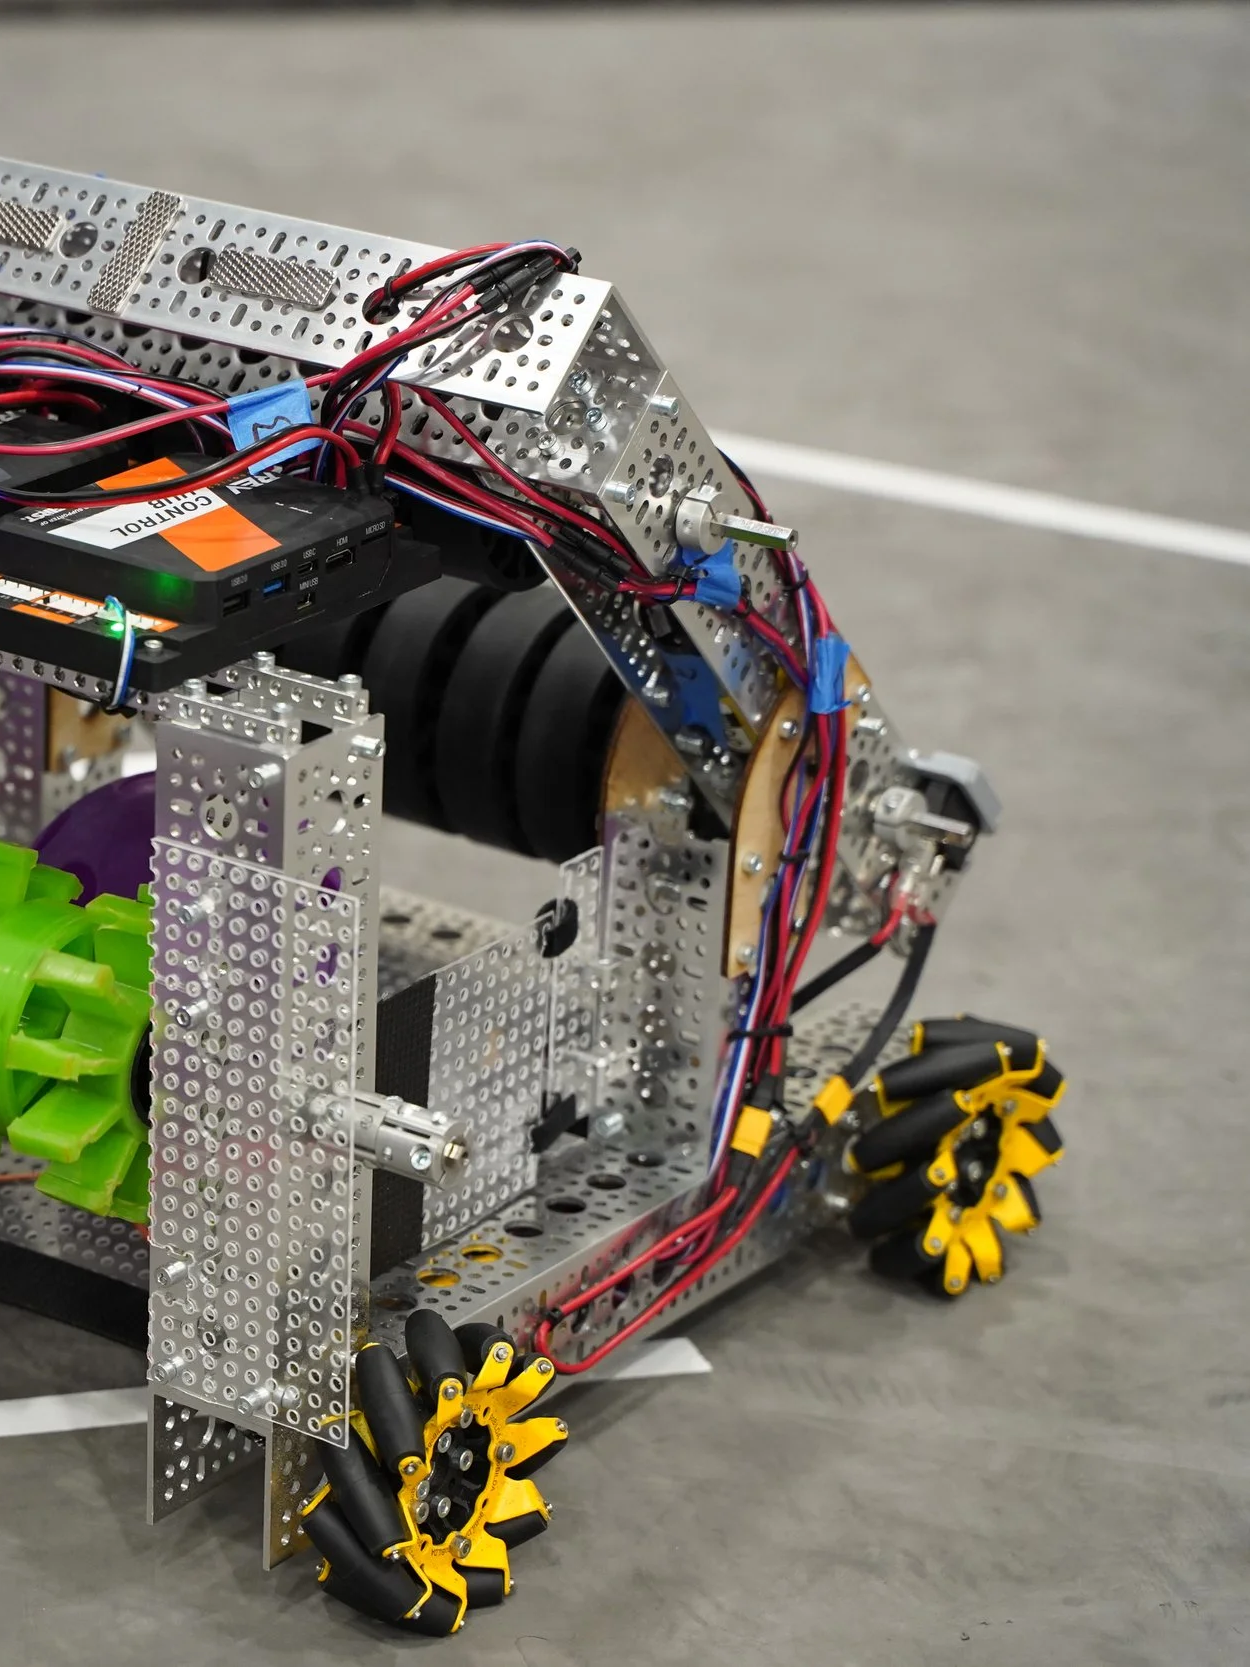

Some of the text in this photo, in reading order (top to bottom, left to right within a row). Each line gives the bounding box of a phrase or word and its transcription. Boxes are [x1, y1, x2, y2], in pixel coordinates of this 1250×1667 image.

[226, 466, 282, 495] REV
[110, 495, 213, 537] CONTROL
[365, 524, 379, 535] MICRO
[336, 536, 349, 547] HDMI
[302, 549, 312, 560] USB
[309, 577, 319, 587] USB
[491, 1459, 502, 1492] oBILDA
